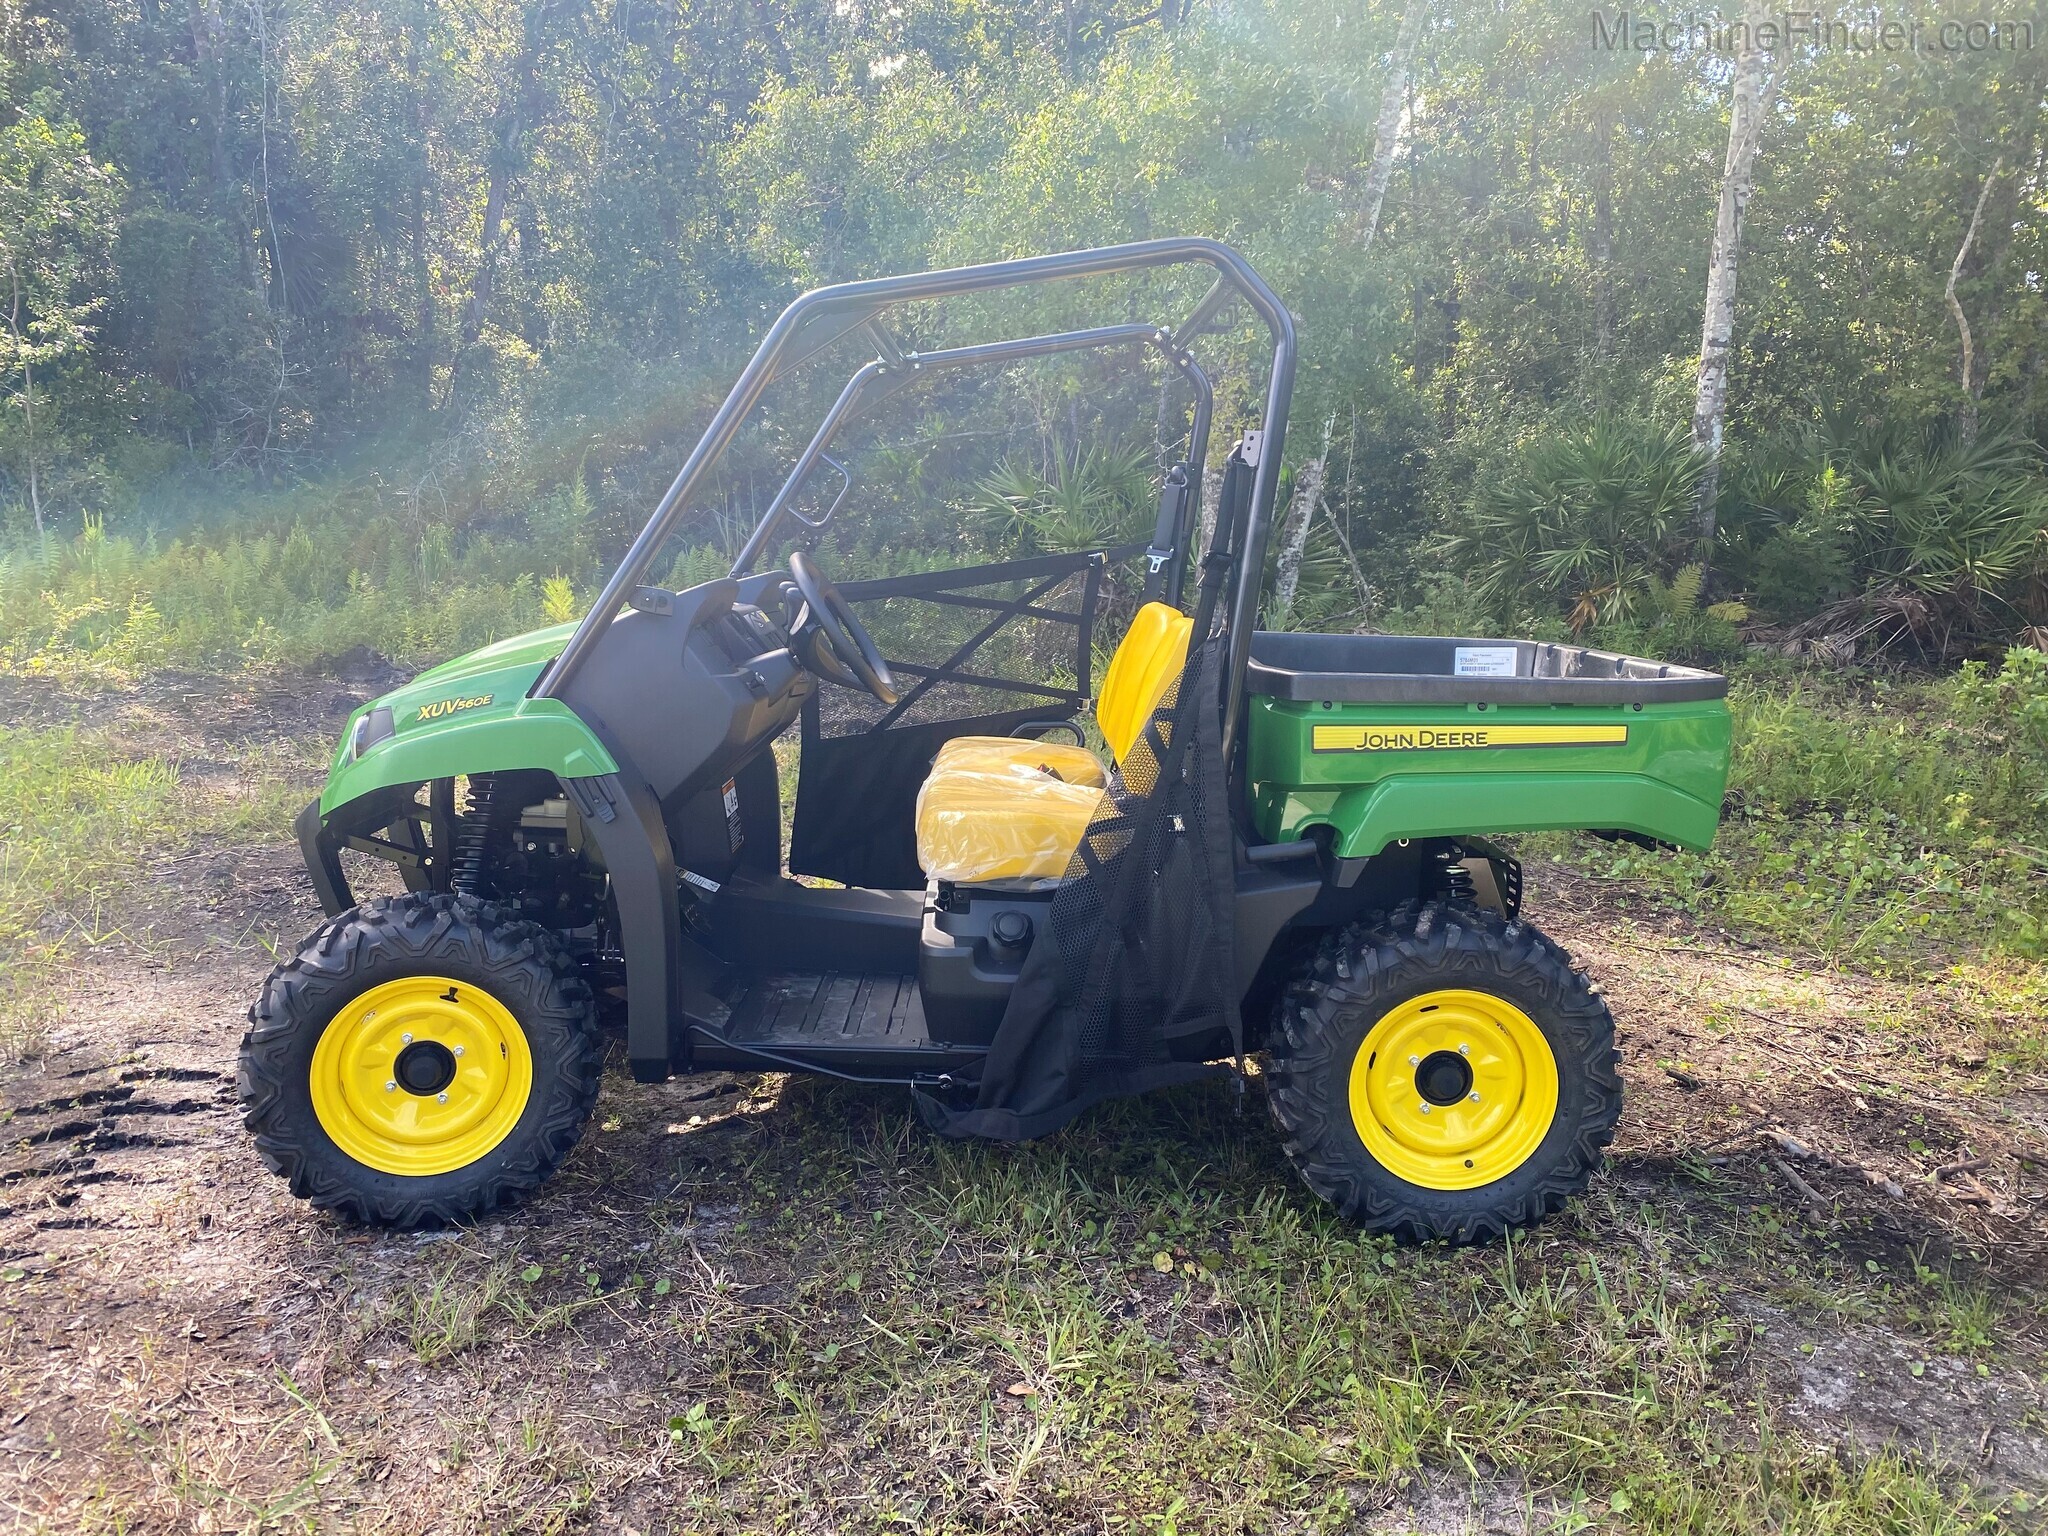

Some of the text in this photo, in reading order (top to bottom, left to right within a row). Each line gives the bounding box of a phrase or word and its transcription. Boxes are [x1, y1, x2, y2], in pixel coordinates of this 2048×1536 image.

[416, 694, 494, 722] XUV560E
[1356, 730, 1488, 748] JOHN DEERE
